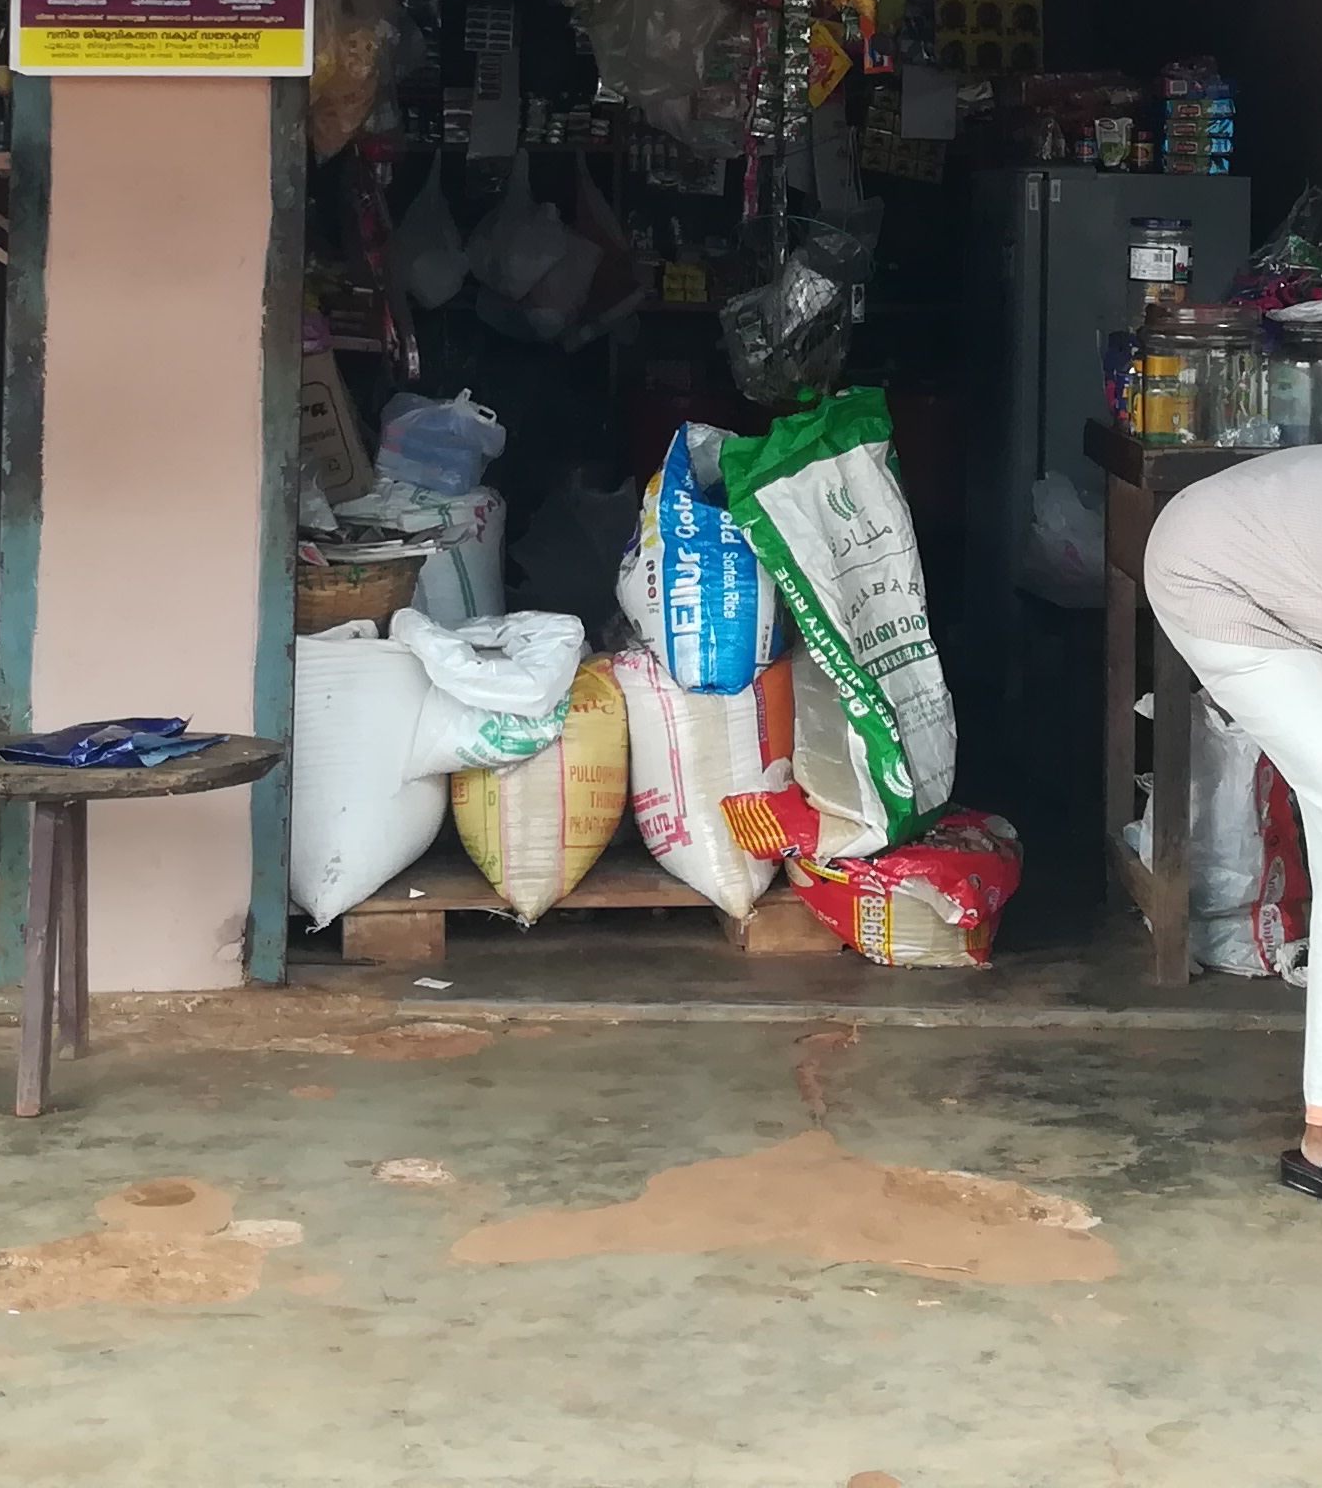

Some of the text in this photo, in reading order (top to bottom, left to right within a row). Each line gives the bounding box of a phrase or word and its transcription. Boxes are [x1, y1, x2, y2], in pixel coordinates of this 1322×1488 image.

[670, 546, 702, 634] Ellur
[722, 551, 738, 590] Sortex
[775, 566, 810, 614] RICE
[723, 591, 739, 619] Rice
